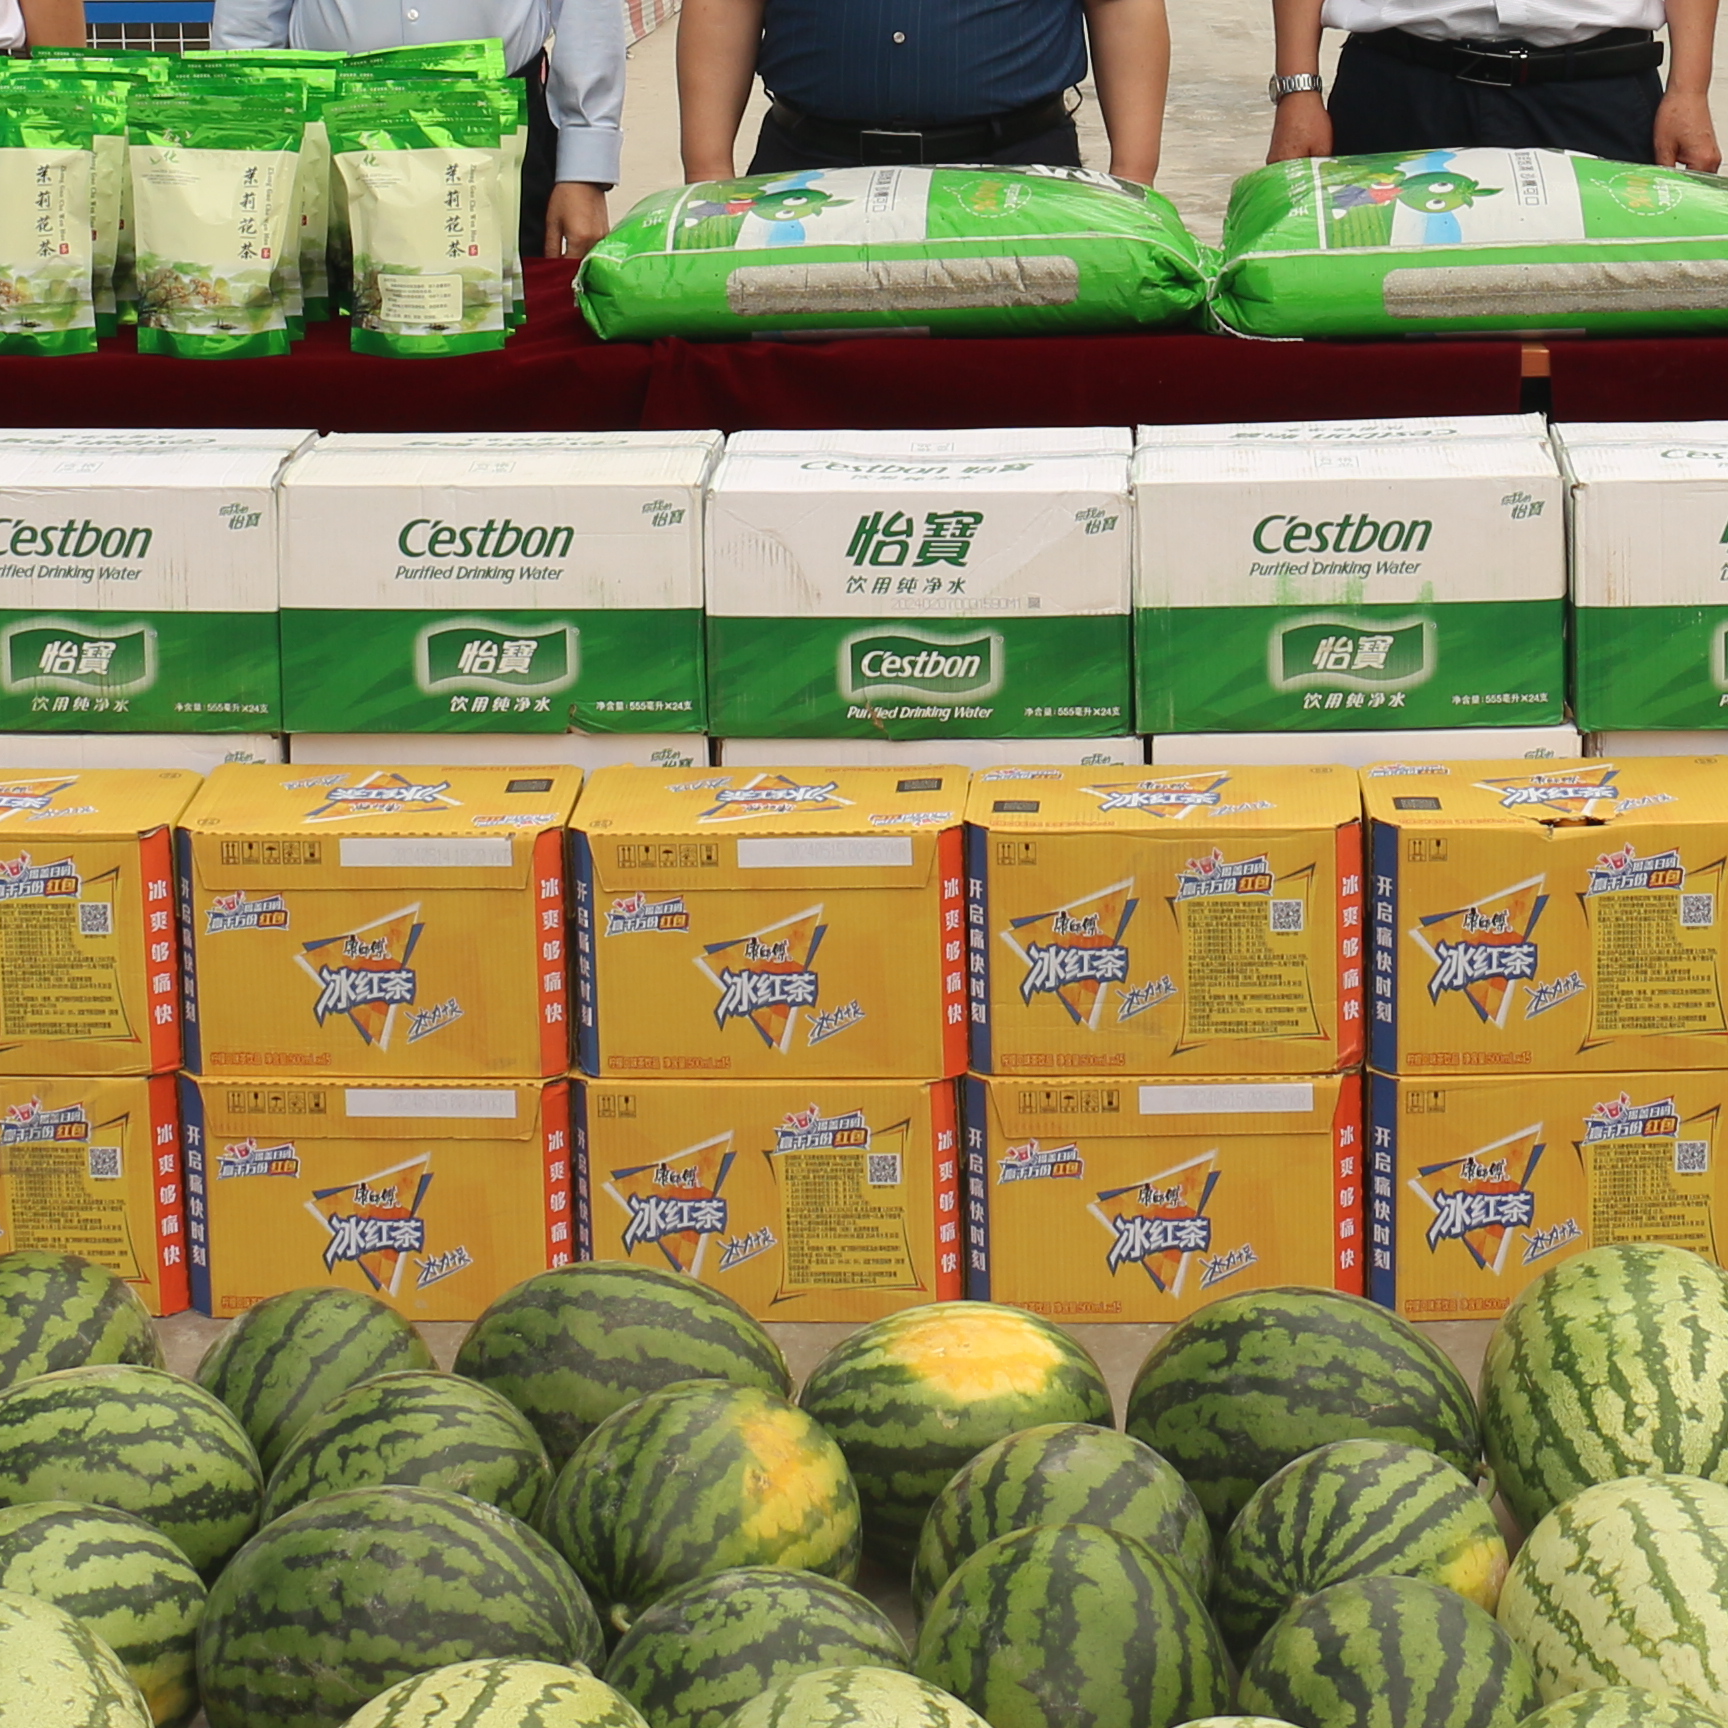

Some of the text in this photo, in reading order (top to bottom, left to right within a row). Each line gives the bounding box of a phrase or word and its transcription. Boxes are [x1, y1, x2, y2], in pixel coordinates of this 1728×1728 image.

[239, 165, 258, 260] 茉莉花茶
[846, 509, 984, 569] 怡寶
[394, 563, 564, 585] Purified Drinking Water
[845, 574, 968, 595] 饮用纯净水
[39, 640, 118, 676] 怡寶
[457, 639, 539, 675] 怡寶
[1311, 634, 1395, 671] 怡寶
[30, 695, 131, 714] 饮用纯净水
[449, 695, 553, 714] 饮用纯净水
[1303, 691, 1406, 710] 饮用纯净水
[1650, 870, 1682, 886] 红包
[1376, 874, 1393, 1023] 开启痛快时刻
[1431, 944, 1535, 988] 冰红茶
[720, 971, 816, 1015] 冰红茶
